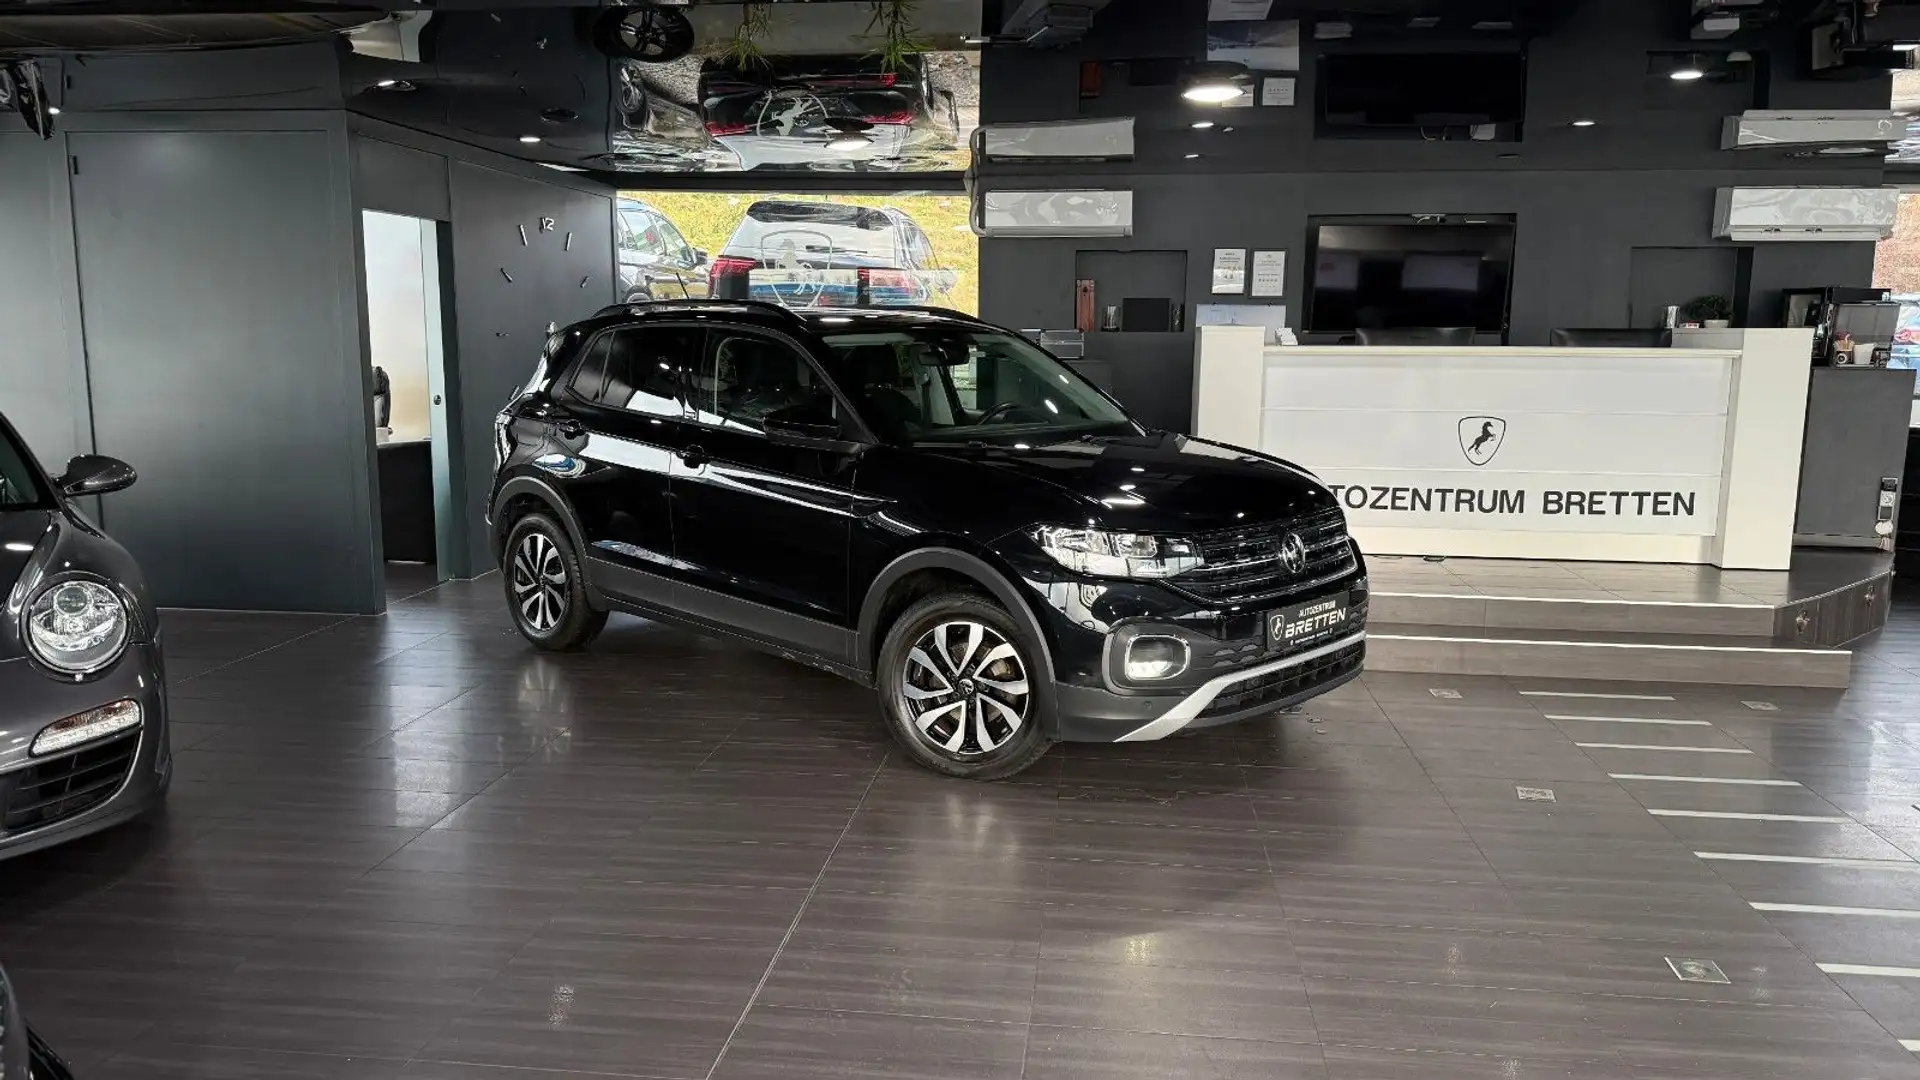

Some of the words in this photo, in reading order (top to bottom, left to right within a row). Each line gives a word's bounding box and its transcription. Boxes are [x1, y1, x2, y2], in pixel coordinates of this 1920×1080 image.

[541, 217, 555, 232] 12
[1327, 485, 1525, 514] TOZENTRUM
[1542, 490, 1696, 517] BRETTEN
[1299, 601, 1336, 617] AUTOZENTRUM
[1286, 608, 1346, 638] BRETTEN
